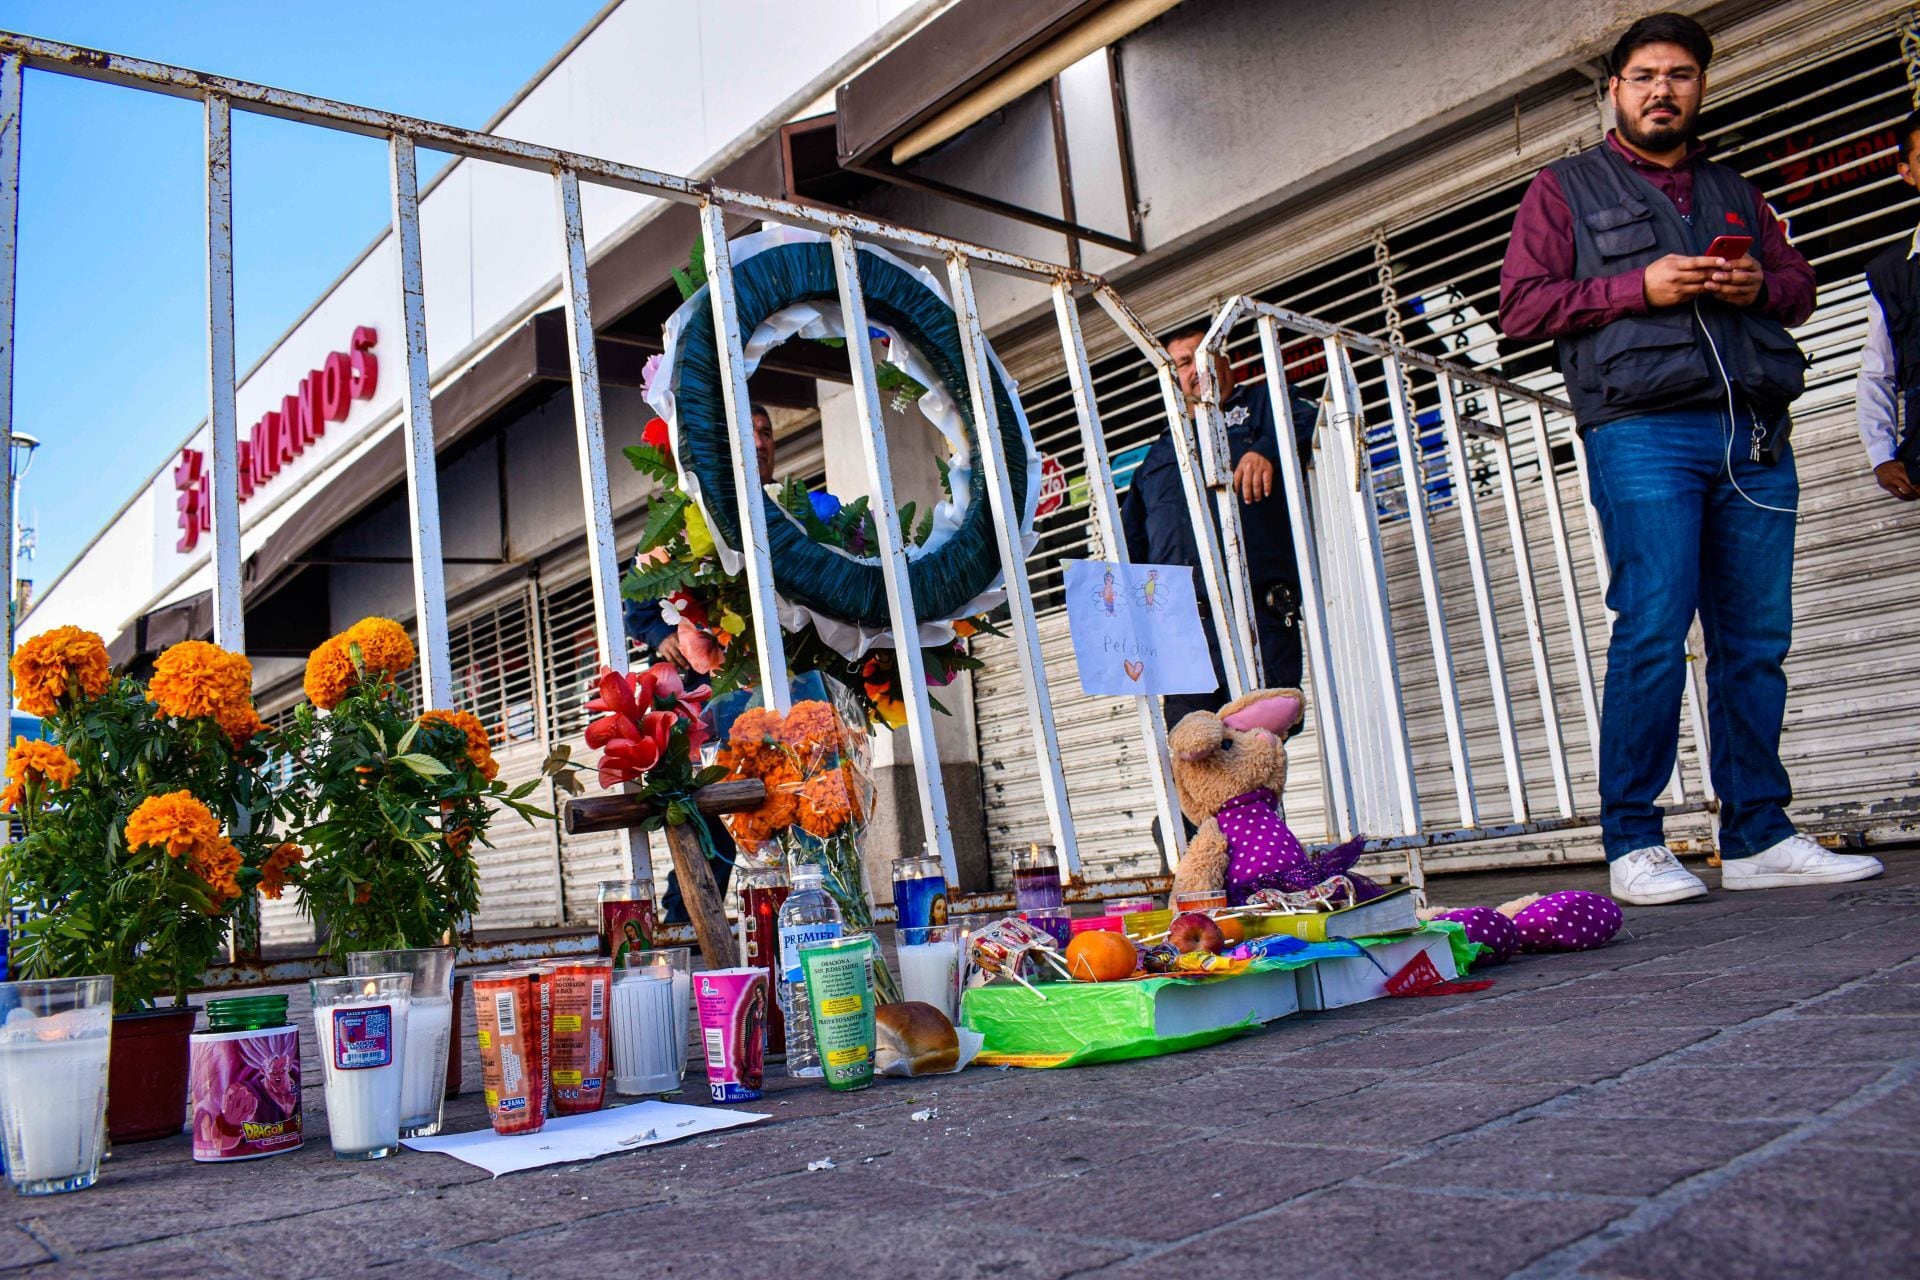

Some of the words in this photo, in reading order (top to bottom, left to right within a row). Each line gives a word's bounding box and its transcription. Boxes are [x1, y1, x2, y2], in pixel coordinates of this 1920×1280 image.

[711, 1084, 724, 1099] 21
[727, 1092, 749, 1100] VIRGEN
[508, 1097, 525, 1106] FAMA
[242, 1121, 284, 1140] DRAGON
